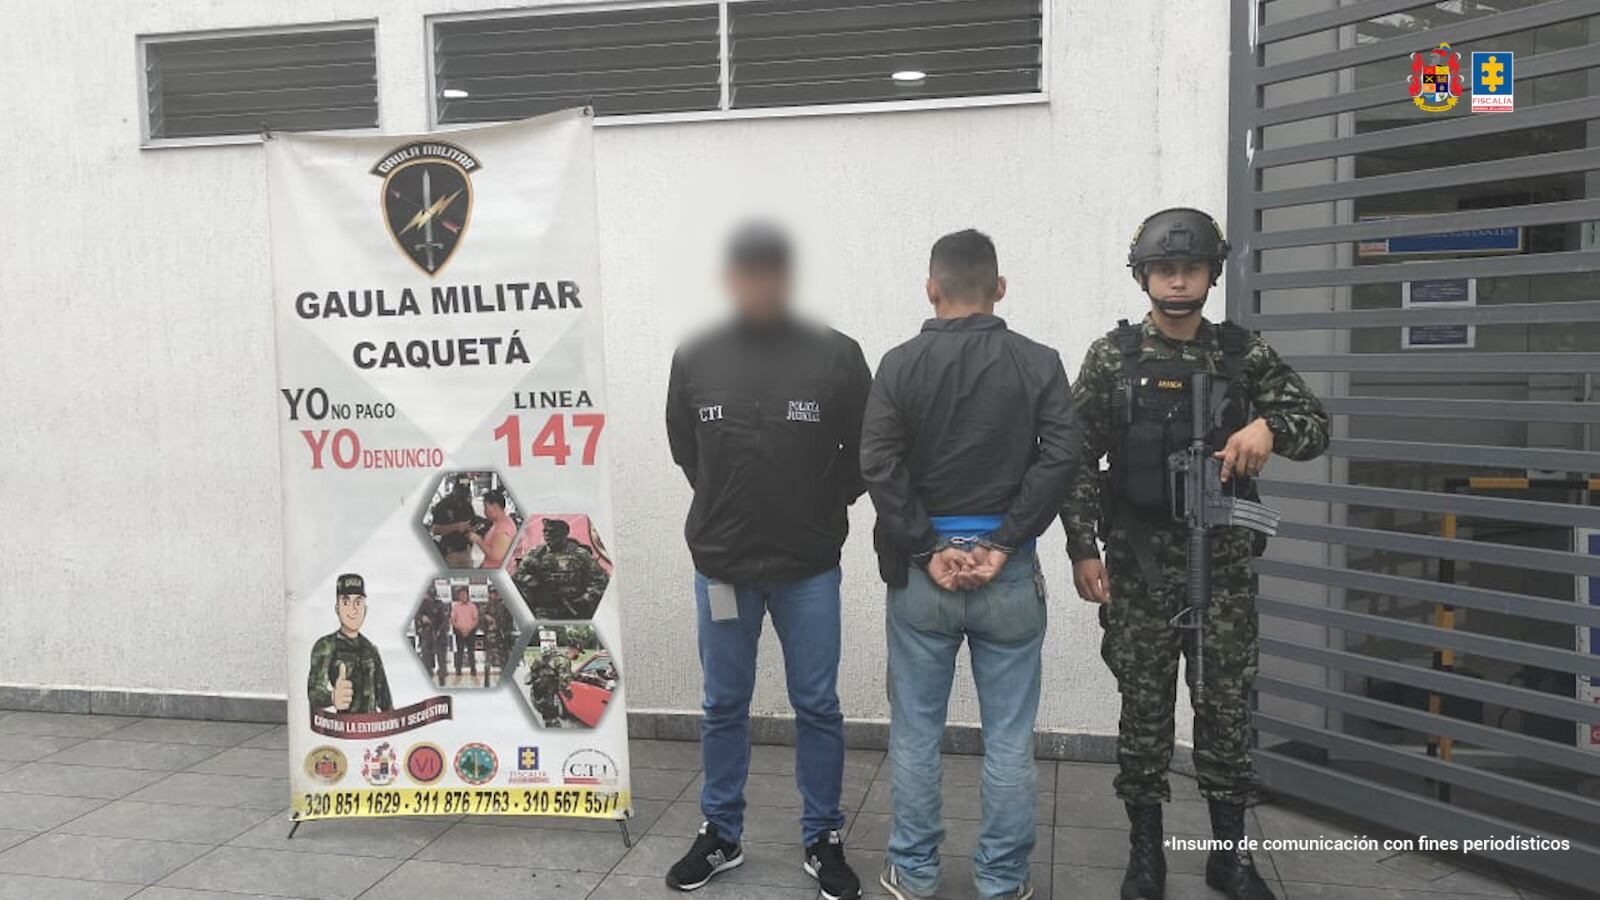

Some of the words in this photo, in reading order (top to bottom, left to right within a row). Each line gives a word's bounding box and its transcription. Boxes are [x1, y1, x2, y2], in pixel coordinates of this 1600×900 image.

[378, 146, 420, 173] GAULA
[422, 145, 476, 169] MILITAR
[295, 287, 421, 319] GAULA
[432, 280, 582, 315] MILITAR
[353, 330, 530, 369] CAQUETÁ
[281, 387, 329, 420] YO
[331, 404, 351, 420] NO
[356, 403, 396, 419] PAGO
[513, 390, 594, 409] LINEA
[699, 405, 723, 422] CTI
[300, 428, 360, 470] YO
[363, 448, 444, 469] DENUNCIO
[494, 413, 606, 467] 147
[314, 715, 345, 732] CONTRA
[346, 722, 356, 733] LA
[415, 757, 435, 774] VI
[305, 794, 331, 816] 320
[335, 793, 360, 815] 851
[366, 792, 400, 814] 1629
[413, 792, 438, 813] 311
[444, 791, 470, 813] 876
[475, 791, 510, 813] 7763
[523, 791, 549, 813] 310
[554, 791, 580, 813] 567
